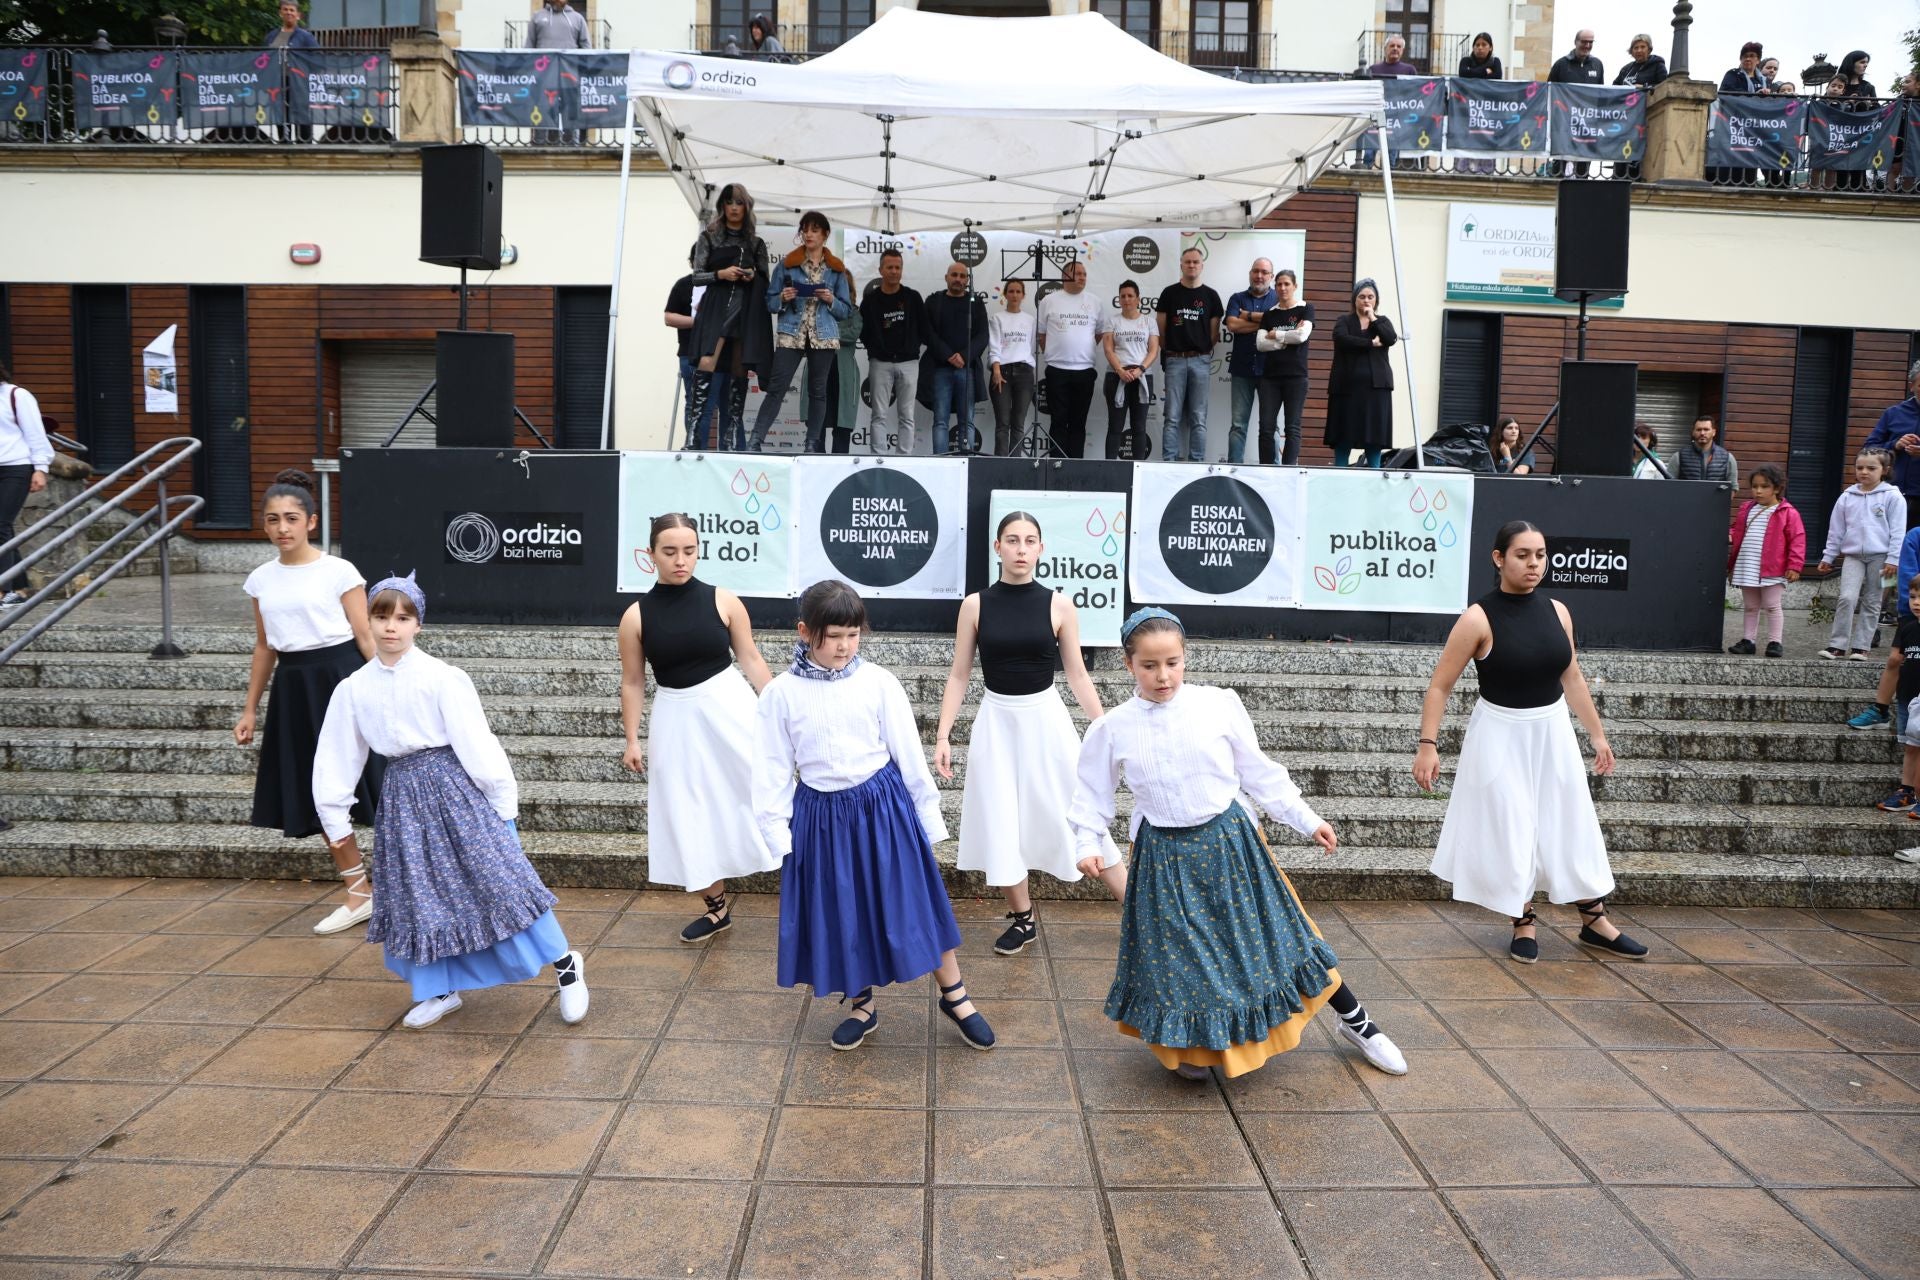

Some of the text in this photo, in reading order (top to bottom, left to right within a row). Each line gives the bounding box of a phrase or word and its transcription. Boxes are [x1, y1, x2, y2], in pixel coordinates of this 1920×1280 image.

[91, 73, 153, 85] PUBLIKOA
[198, 73, 258, 85] PUBLIKOA
[309, 74, 367, 86] PUBLIKOA
[477, 74, 537, 85] PUBLIKOA
[580, 76, 629, 87] PUBLIK
[701, 70, 757, 87] ordizia
[92, 84, 109, 94] DA
[199, 85, 215, 95] DA
[309, 83, 326, 93] DA
[478, 84, 493, 94] DA
[580, 86, 598, 96] DA
[93, 94, 129, 105] BIDEA
[199, 94, 235, 105] BIDEA
[309, 92, 345, 105] BIDEA
[477, 93, 511, 104] BIDEA
[580, 95, 617, 106] BIDEA
[1469, 99, 1528, 112] PUBLIKOA
[1470, 109, 1485, 119] DA
[1571, 106, 1628, 121] PUBLIKOA
[1469, 117, 1504, 129] BIDEA
[1570, 117, 1587, 127] DA
[1729, 116, 1788, 129] PUBLIKOA
[1571, 126, 1605, 137] BIDEA
[1730, 126, 1745, 136] DA
[1829, 132, 1845, 142] DA
[1730, 135, 1763, 147] BIDEA
[1499, 247, 1510, 256] de
[1452, 283, 1524, 293] Hizkuntza eskola ofiziala
[852, 497, 908, 512] EUSKAL
[1191, 505, 1246, 520] EUSKAL
[851, 513, 908, 528] ESKOLA
[502, 522, 582, 545] ordizia
[1190, 521, 1246, 536] ESKOLA
[829, 529, 929, 544] PUBLIKOAREN
[1330, 530, 1438, 554] publikoa
[1167, 536, 1266, 552] PUBLIKOAREN
[503, 546, 563, 559] bizi herria
[718, 541, 758, 562] do!
[862, 545, 896, 559] JAIA
[1199, 553, 1233, 567] JAIA
[1551, 548, 1628, 570] ordizia
[999, 557, 1118, 580] blikoa
[1396, 558, 1435, 578] do!
[1552, 570, 1609, 584] bizi herria
[1072, 587, 1116, 609] do!
